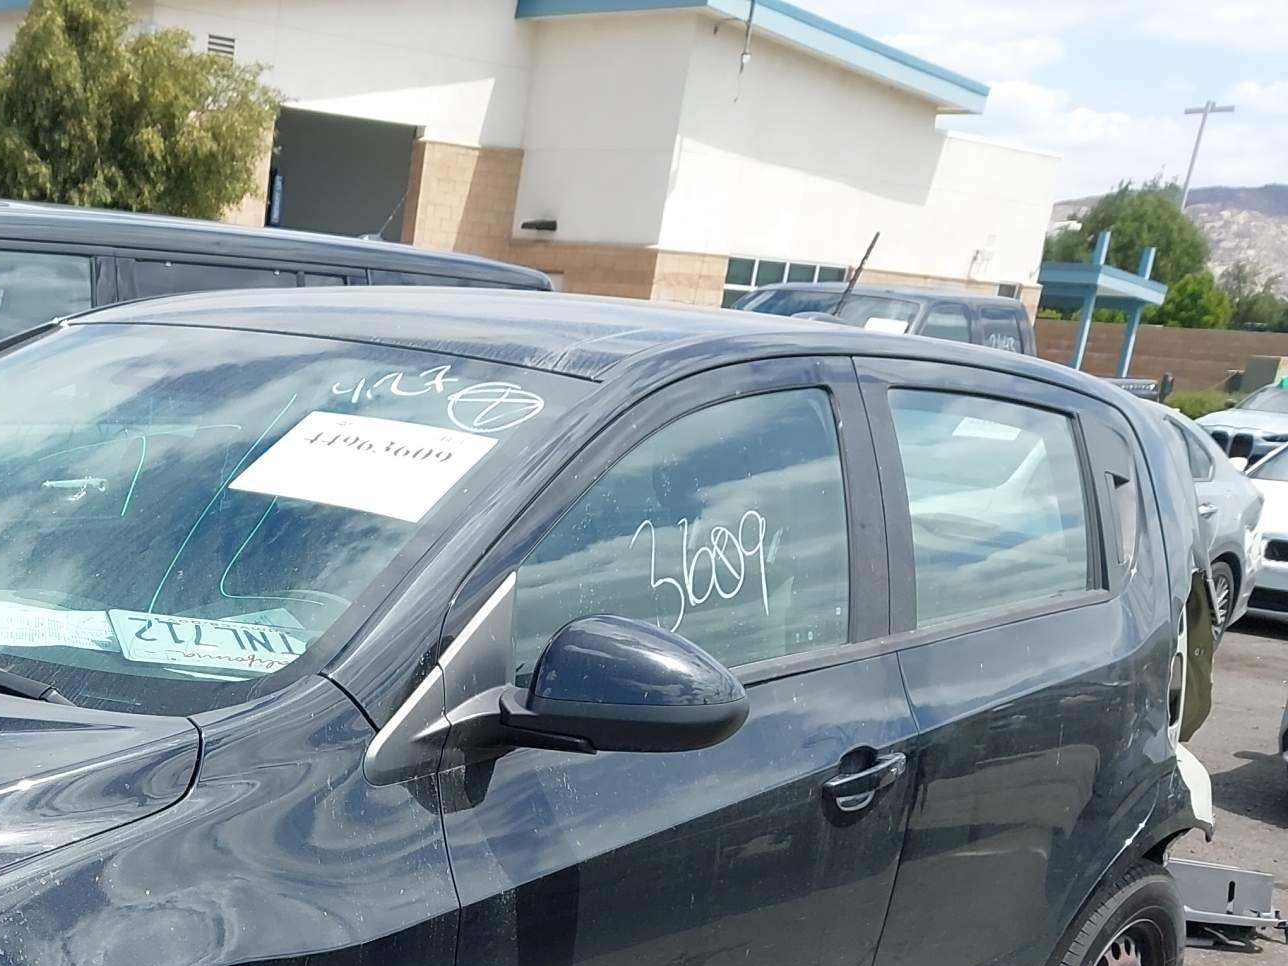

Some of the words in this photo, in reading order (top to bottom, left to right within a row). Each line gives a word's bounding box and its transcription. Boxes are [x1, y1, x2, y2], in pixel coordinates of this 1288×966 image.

[303, 431, 453, 464] 44963609
[630, 509, 770, 633] 3609
[127, 615, 219, 648] 712
[214, 627, 300, 656] TNL
[183, 650, 289, 670] alifornia
